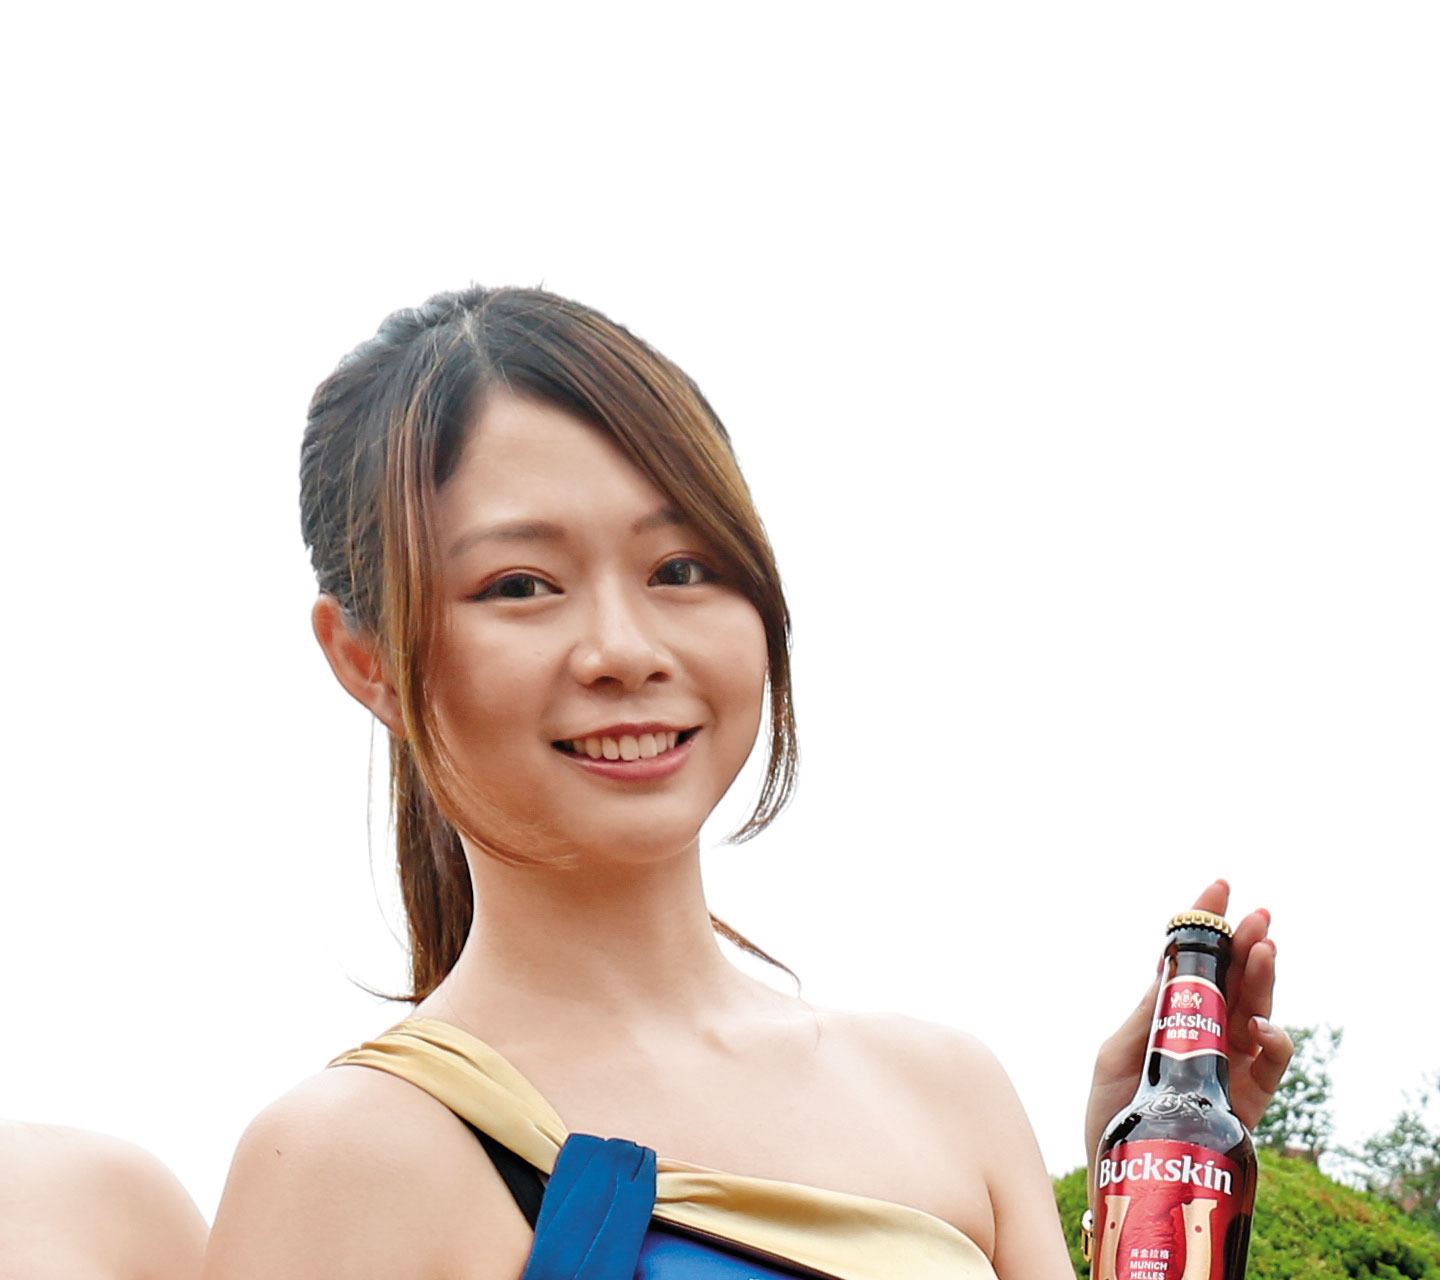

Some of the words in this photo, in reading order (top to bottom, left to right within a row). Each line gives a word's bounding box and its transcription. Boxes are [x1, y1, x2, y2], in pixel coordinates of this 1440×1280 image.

[1099, 1152, 1233, 1196] Buckskin
[1129, 1260, 1168, 1271] MUNICH
[1130, 1271, 1165, 1280] HELLES
